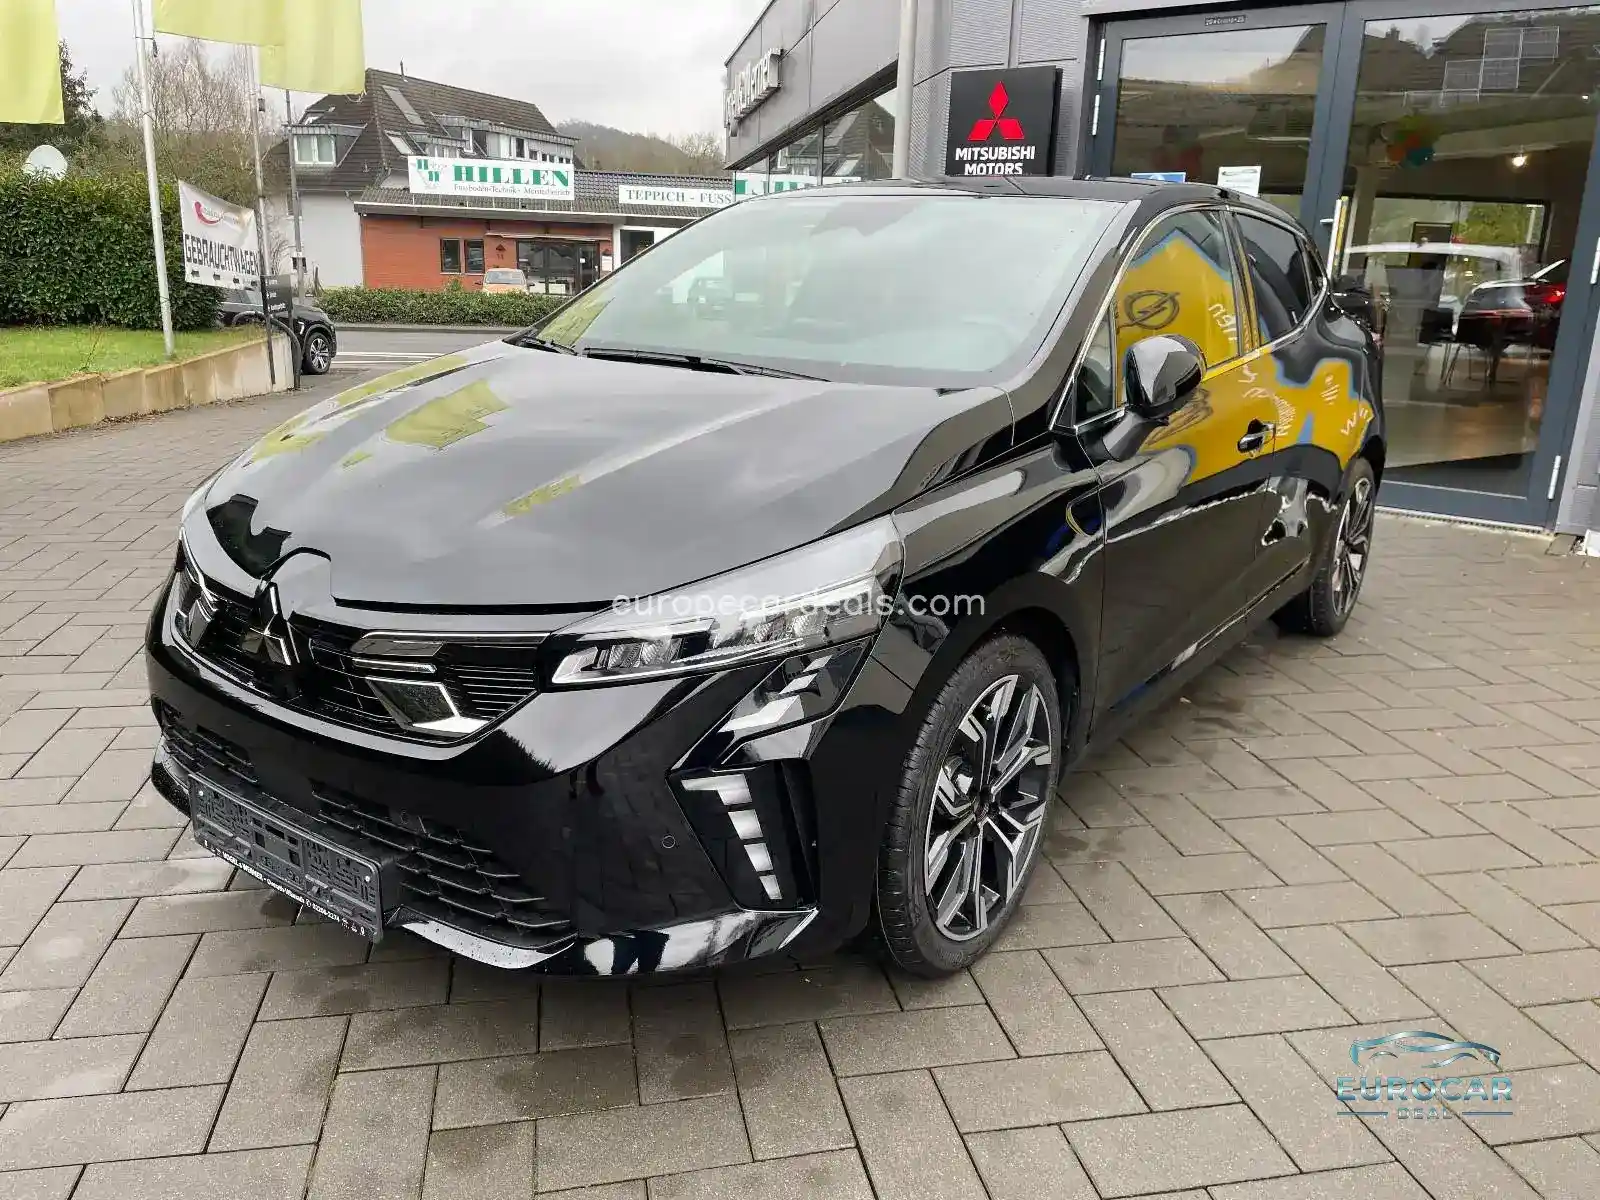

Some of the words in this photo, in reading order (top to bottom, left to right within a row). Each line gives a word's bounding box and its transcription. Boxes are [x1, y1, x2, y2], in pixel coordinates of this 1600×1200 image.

[955, 145, 1036, 161] MITSUBISHI
[452, 165, 570, 187] HILLEN
[964, 162, 1024, 176] MOTORS
[626, 189, 685, 202] TEPPICH
[184, 233, 260, 276] GEBRAUCHTWAGEN
